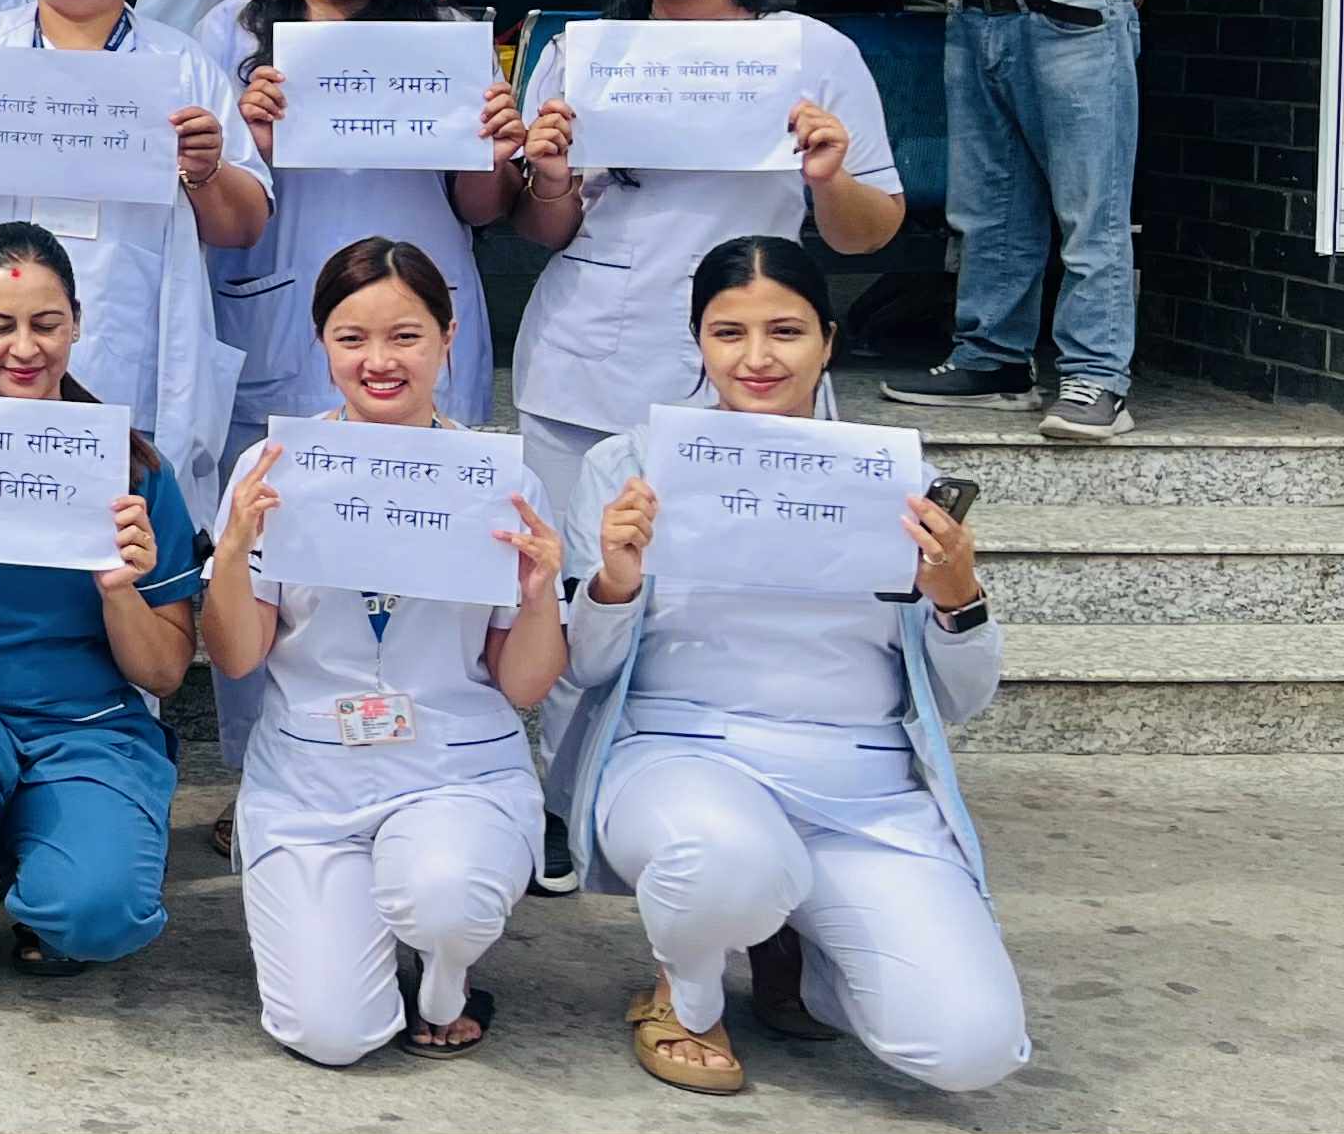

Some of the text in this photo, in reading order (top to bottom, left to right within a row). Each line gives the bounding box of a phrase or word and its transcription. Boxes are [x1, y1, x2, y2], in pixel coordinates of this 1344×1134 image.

[316, 68, 452, 94] नर्सको श्रमको
[589, 61, 637, 79] नियमले
[641, 61, 672, 78] तोके
[44, 95, 100, 118] नेपालमै
[679, 91, 732, 104] व्यवस्था
[736, 91, 758, 104] गर
[329, 118, 438, 137] सम्मान गर
[295, 444, 358, 475] थकित
[457, 455, 497, 488] अझै
[678, 435, 745, 466] थकित
[852, 447, 896, 481] अझै
[333, 496, 452, 531] पनि सेवामा
[719, 488, 849, 524] पनि सेवामा
